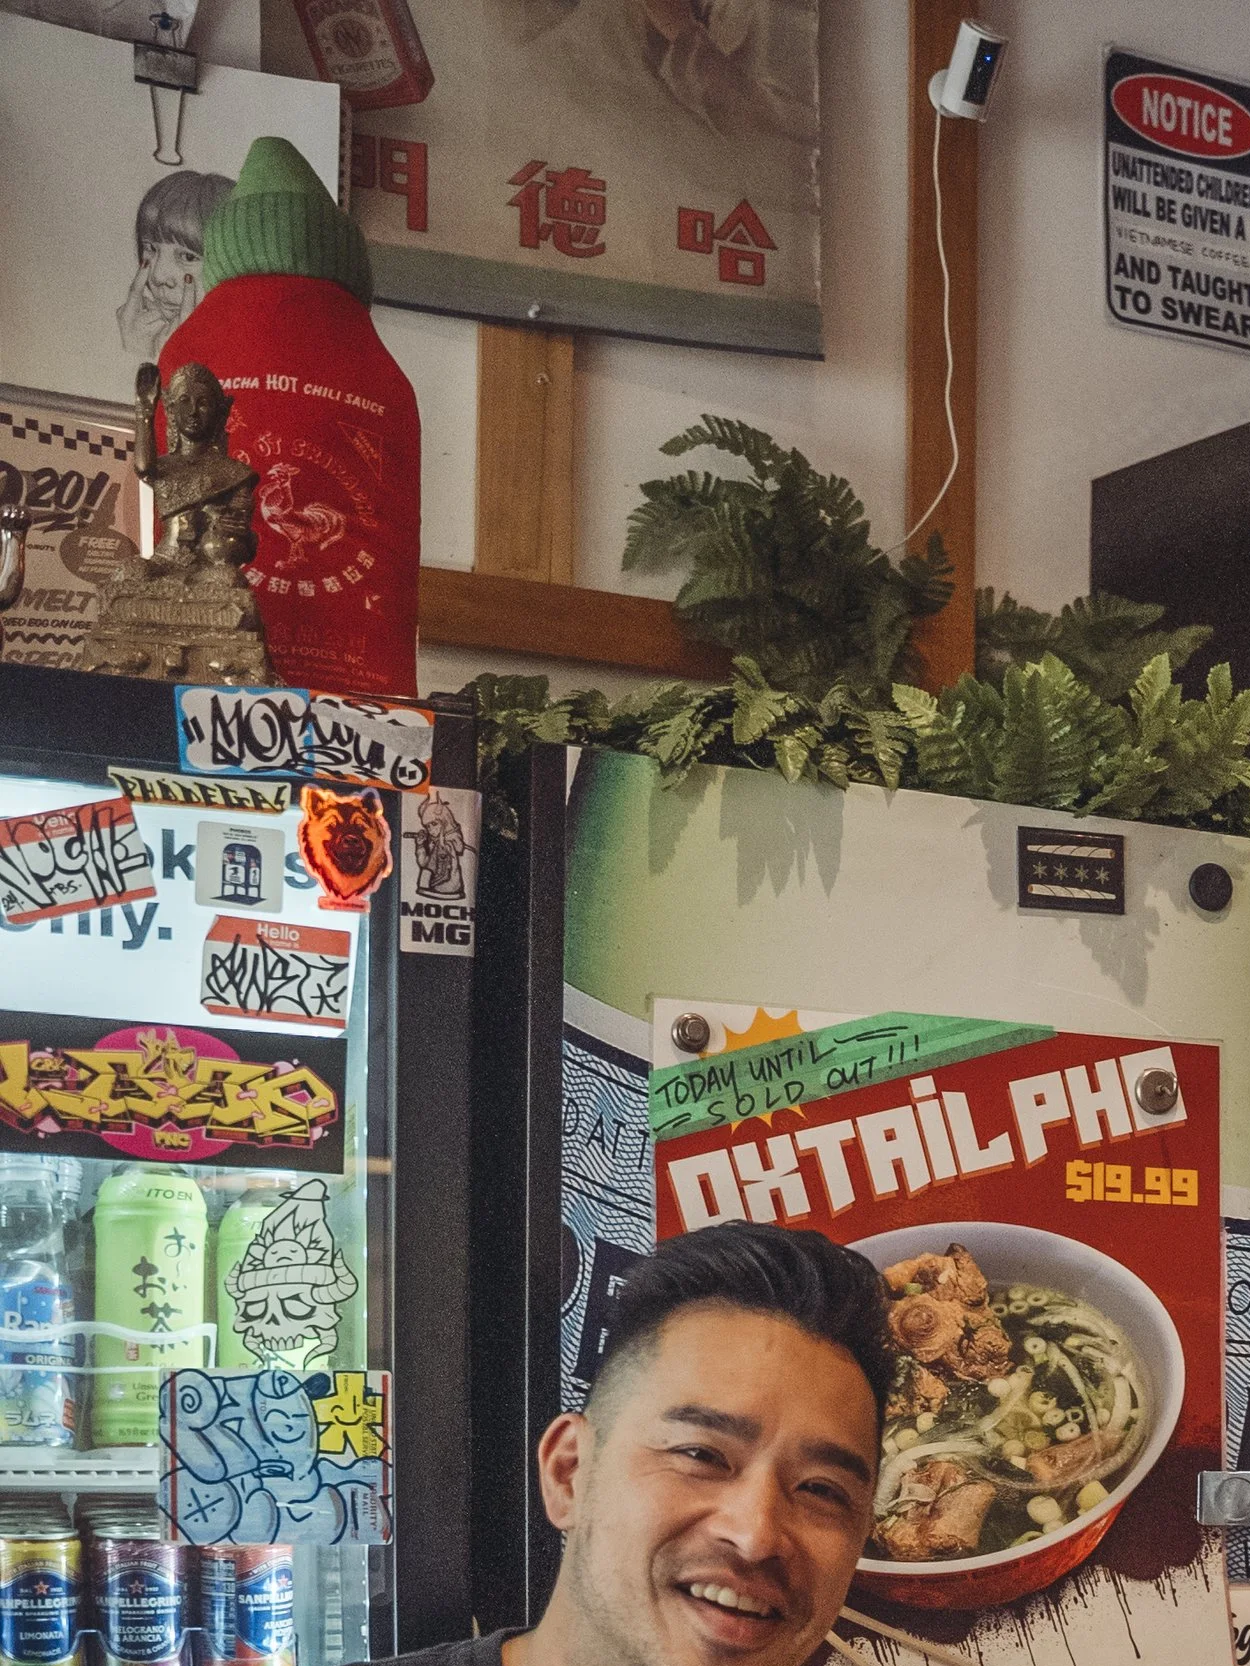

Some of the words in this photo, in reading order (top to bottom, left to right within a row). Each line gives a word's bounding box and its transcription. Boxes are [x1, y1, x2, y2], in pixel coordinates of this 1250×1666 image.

[1141, 87, 1233, 147] NOTICE
[1112, 151, 1193, 196] UNATTENDED
[1112, 185, 1151, 220] WILL
[1156, 196, 1177, 225] BE
[1181, 202, 1231, 239] GIVEN
[1232, 216, 1246, 242] A
[1113, 253, 1161, 286] AND
[1113, 286, 1151, 316] TO
[265, 374, 299, 393] HOT
[303, 383, 341, 401] CHILI
[344, 393, 385, 417] SAUCE
[256, 922, 300, 941] Hello
[412, 920, 471, 946] MG
[653, 1059, 738, 1117] TODAY
[750, 1036, 838, 1083] UNTIL
[706, 1081, 805, 1127] SOLD
[667, 1075, 1014, 1233] OXTAIL
[1016, 1045, 1190, 1142] PHO
[146, 1188, 175, 1199] ITO
[177, 1191, 193, 1201] EN
[1065, 1160, 1200, 1207] $19.99
[19, 1630, 65, 1641] LIMONATA
